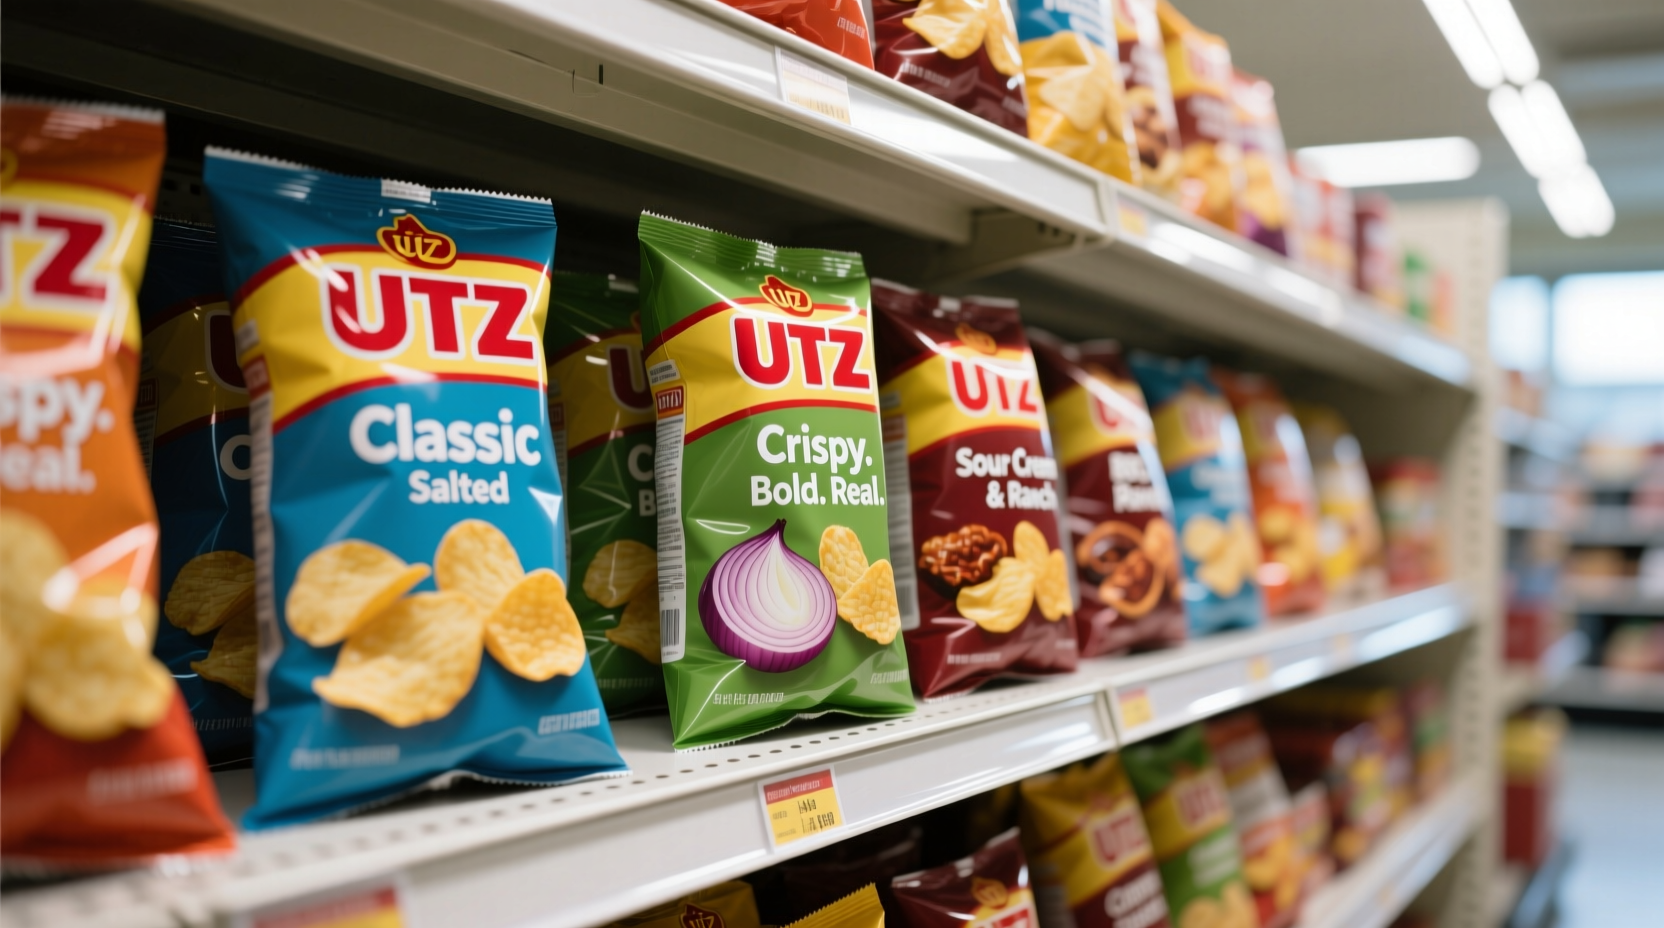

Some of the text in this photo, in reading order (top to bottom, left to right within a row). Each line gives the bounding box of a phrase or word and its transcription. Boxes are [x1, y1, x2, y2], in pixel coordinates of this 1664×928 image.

[322, 263, 540, 364] UTZ
[732, 314, 872, 392] UTZ
[349, 402, 541, 466] Classic
[756, 422, 873, 475] Crispy.
[955, 446, 1010, 478] Sour
[408, 469, 510, 505] Salted
[750, 472, 885, 507] Bold. Real.
[985, 480, 1006, 509] &
